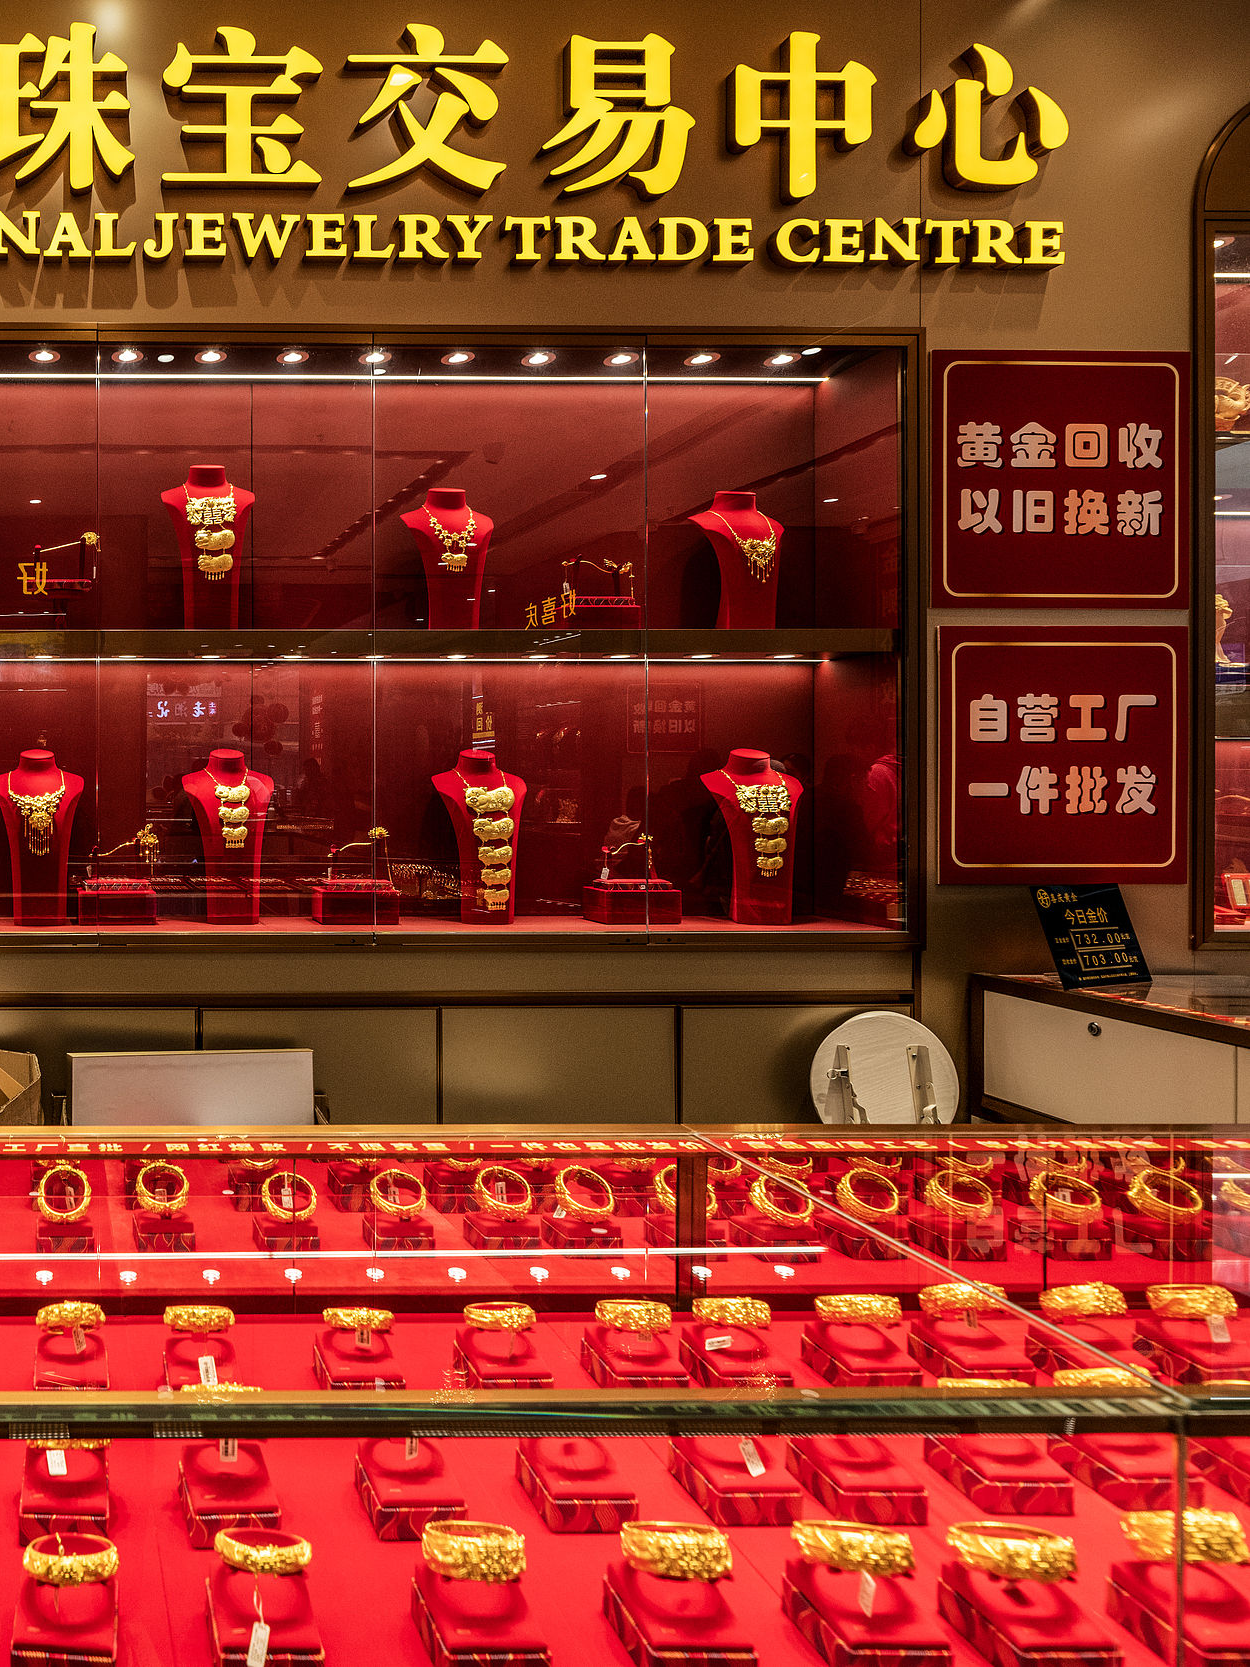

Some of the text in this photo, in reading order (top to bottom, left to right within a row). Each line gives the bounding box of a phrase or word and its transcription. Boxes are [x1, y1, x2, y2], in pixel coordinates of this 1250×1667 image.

[504, 214, 754, 263] TRADE
[775, 216, 1066, 265] CENTRE
[956, 421, 1163, 469] 黄金回收
[957, 488, 1163, 536] 以旧换新
[969, 693, 1157, 742] 自营工厂
[968, 765, 1157, 814] 一件批发
[1064, 906, 1110, 926] 今日金价
[1075, 932, 1121, 945] 732.00
[1083, 951, 1128, 966] 703.00
